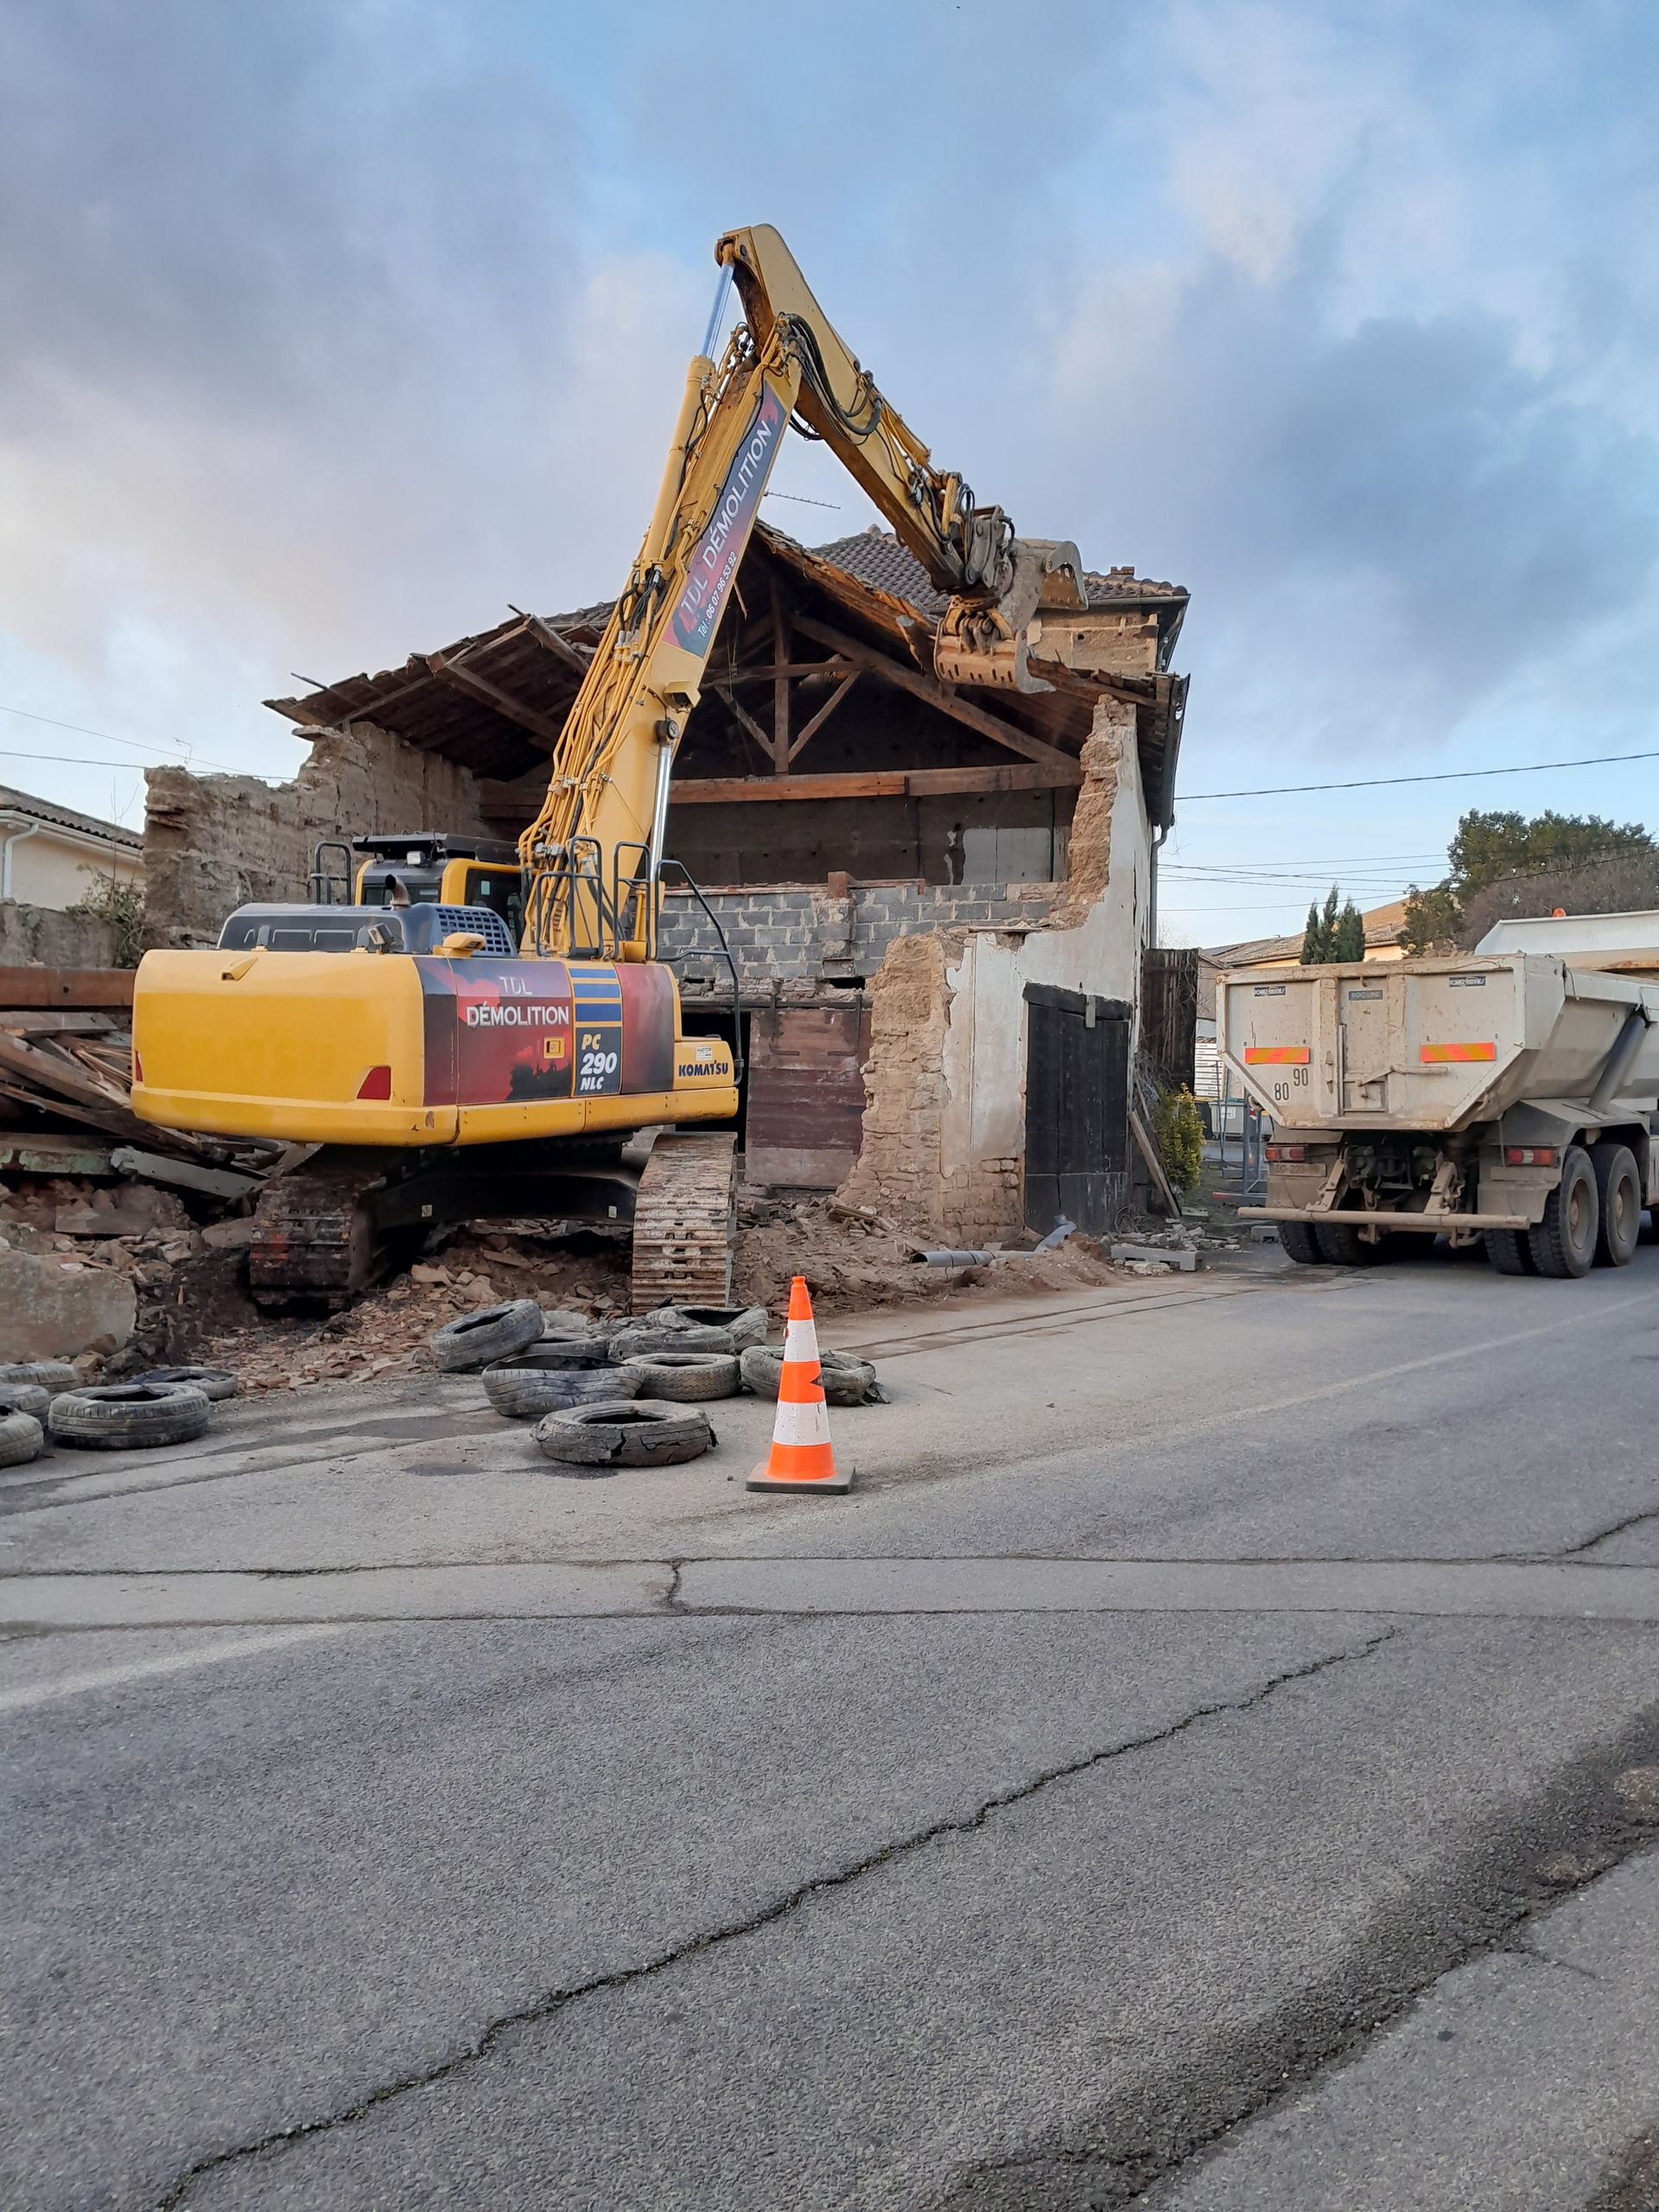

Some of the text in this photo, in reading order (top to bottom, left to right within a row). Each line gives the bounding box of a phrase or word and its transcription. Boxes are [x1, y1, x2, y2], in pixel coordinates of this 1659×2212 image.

[702, 419, 772, 570] DÉMOLITION
[706, 604, 715, 619] 06
[711, 592, 720, 605] 07
[717, 577, 726, 593] 96
[722, 564, 732, 580] 53
[728, 551, 737, 566] 92
[467, 1001, 569, 1027] DÉMOLITION
[582, 1033, 601, 1051] PC
[580, 1052, 618, 1075] 290
[678, 1060, 728, 1077] KOMATSU
[580, 1076, 605, 1091] NLC
[1293, 1067, 1308, 1086] 90
[1274, 1082, 1289, 1101] 80
